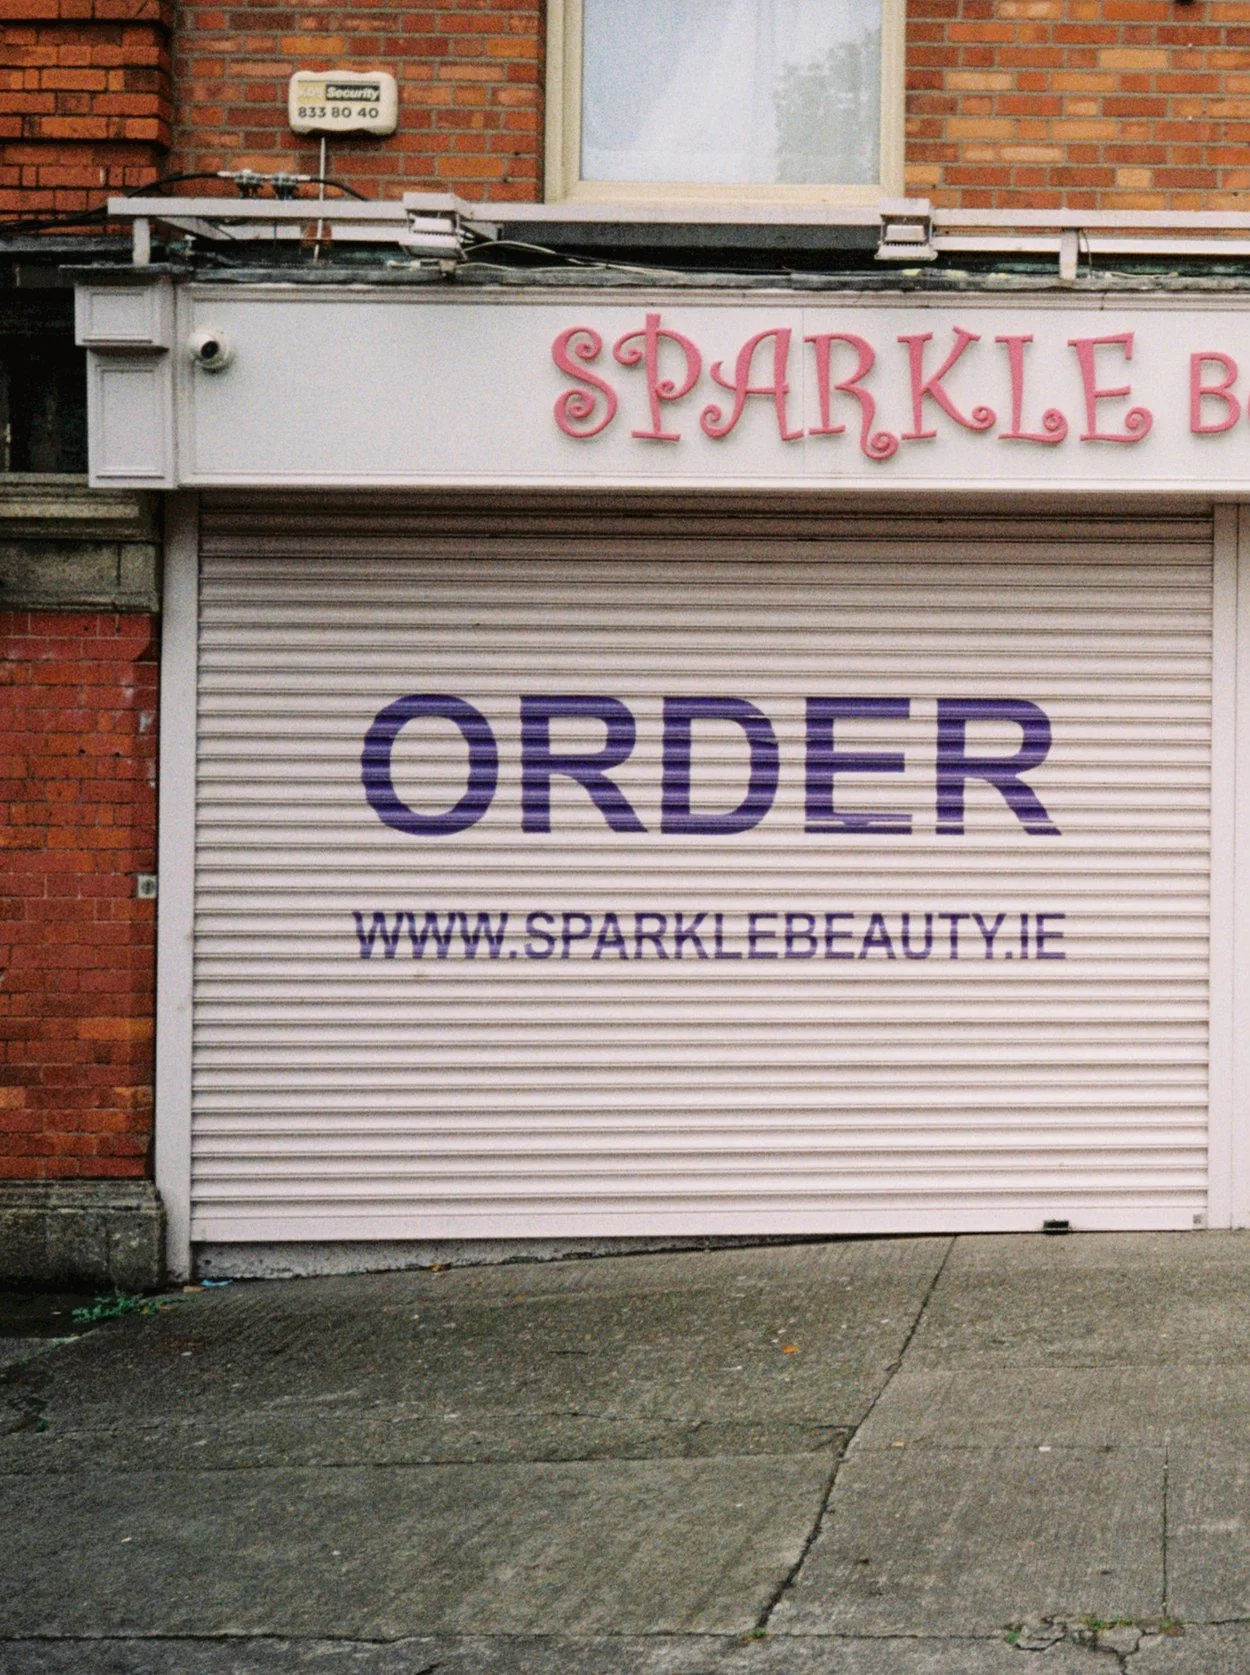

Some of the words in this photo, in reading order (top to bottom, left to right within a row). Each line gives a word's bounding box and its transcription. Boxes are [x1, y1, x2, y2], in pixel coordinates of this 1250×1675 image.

[298, 107, 327, 118] 833
[331, 107, 352, 118] 80
[357, 107, 379, 118] 40
[327, 86, 380, 100] Security
[552, 313, 1152, 461] SPARKLE
[361, 693, 1062, 836] ORDER
[353, 911, 1067, 962] WWW.SPARKLEBEAUTY.IE
